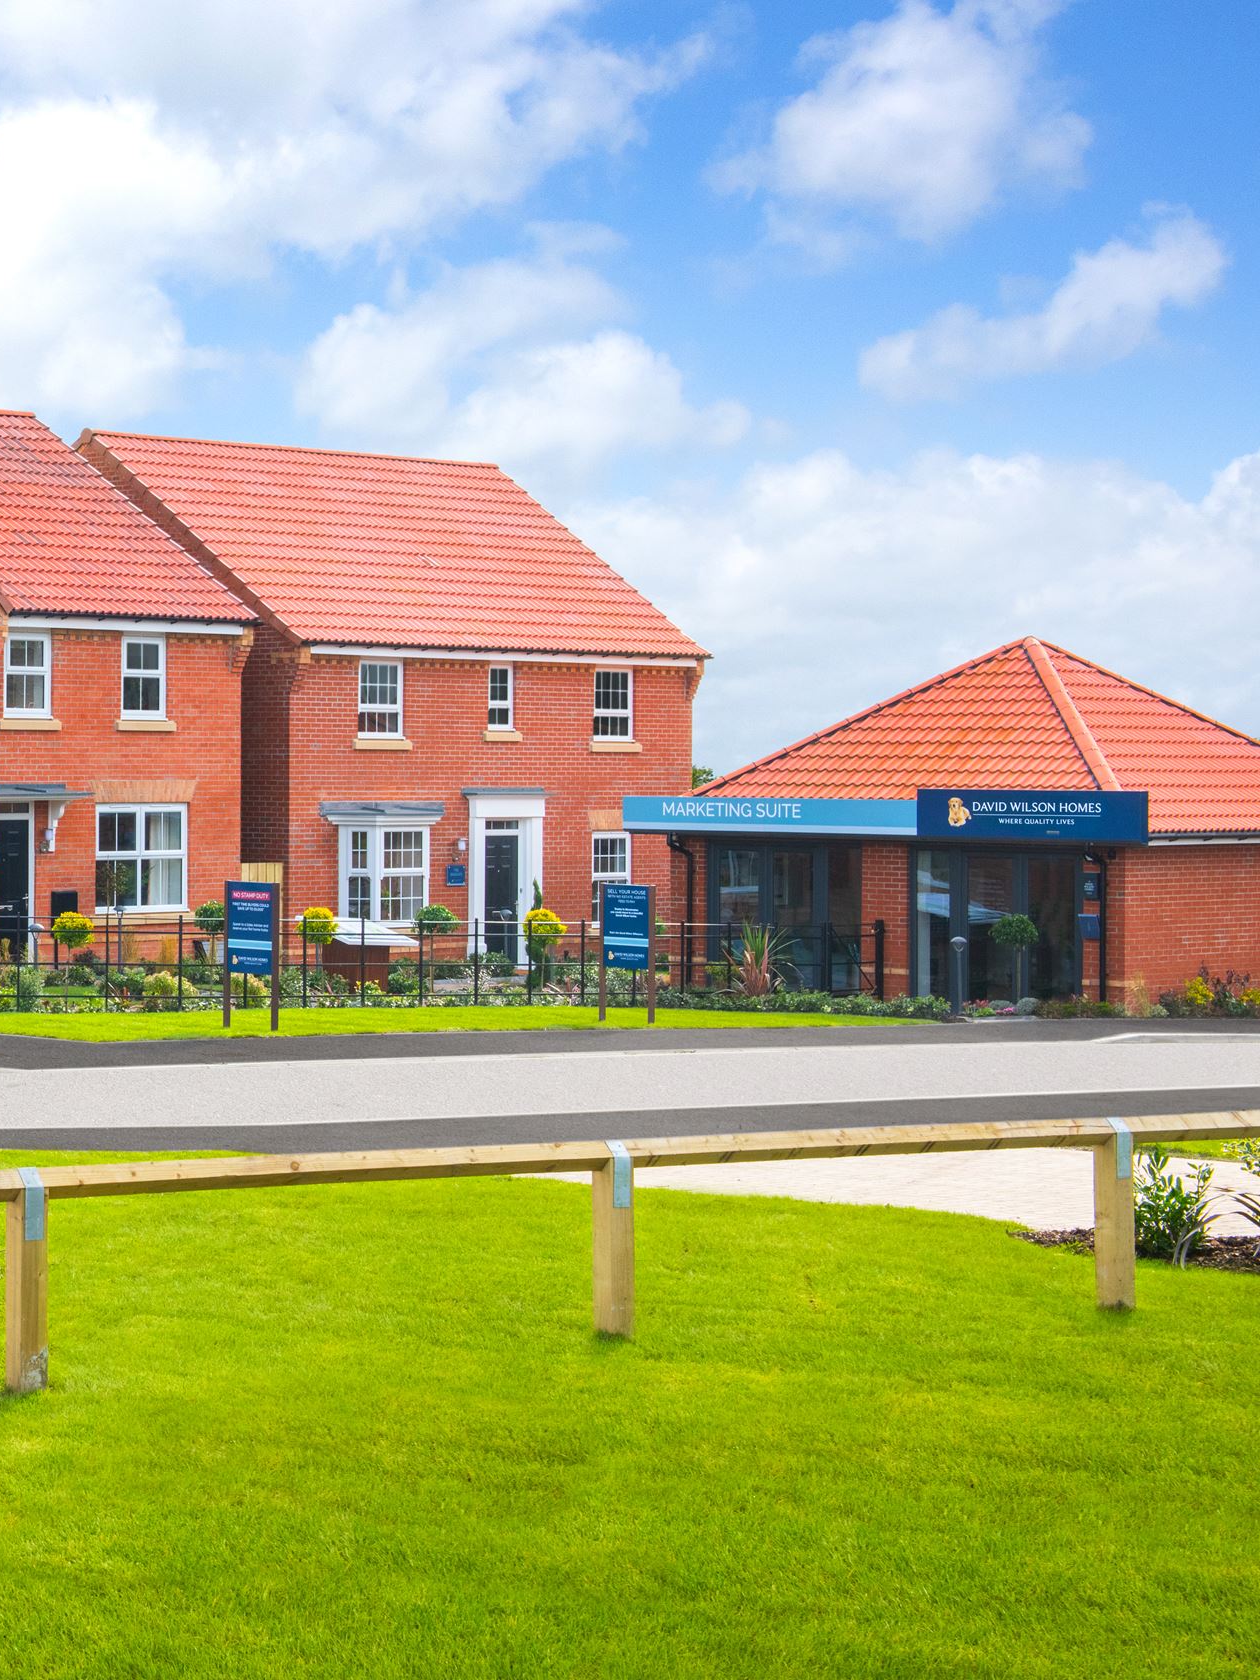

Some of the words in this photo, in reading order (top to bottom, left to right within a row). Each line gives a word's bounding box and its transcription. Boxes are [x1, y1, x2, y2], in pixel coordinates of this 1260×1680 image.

[662, 802, 752, 817] MARKETING
[756, 802, 802, 818] SUITE
[972, 802, 1007, 812] DAVID
[1010, 802, 1055, 812] WILSON
[1059, 802, 1101, 812] HOMES
